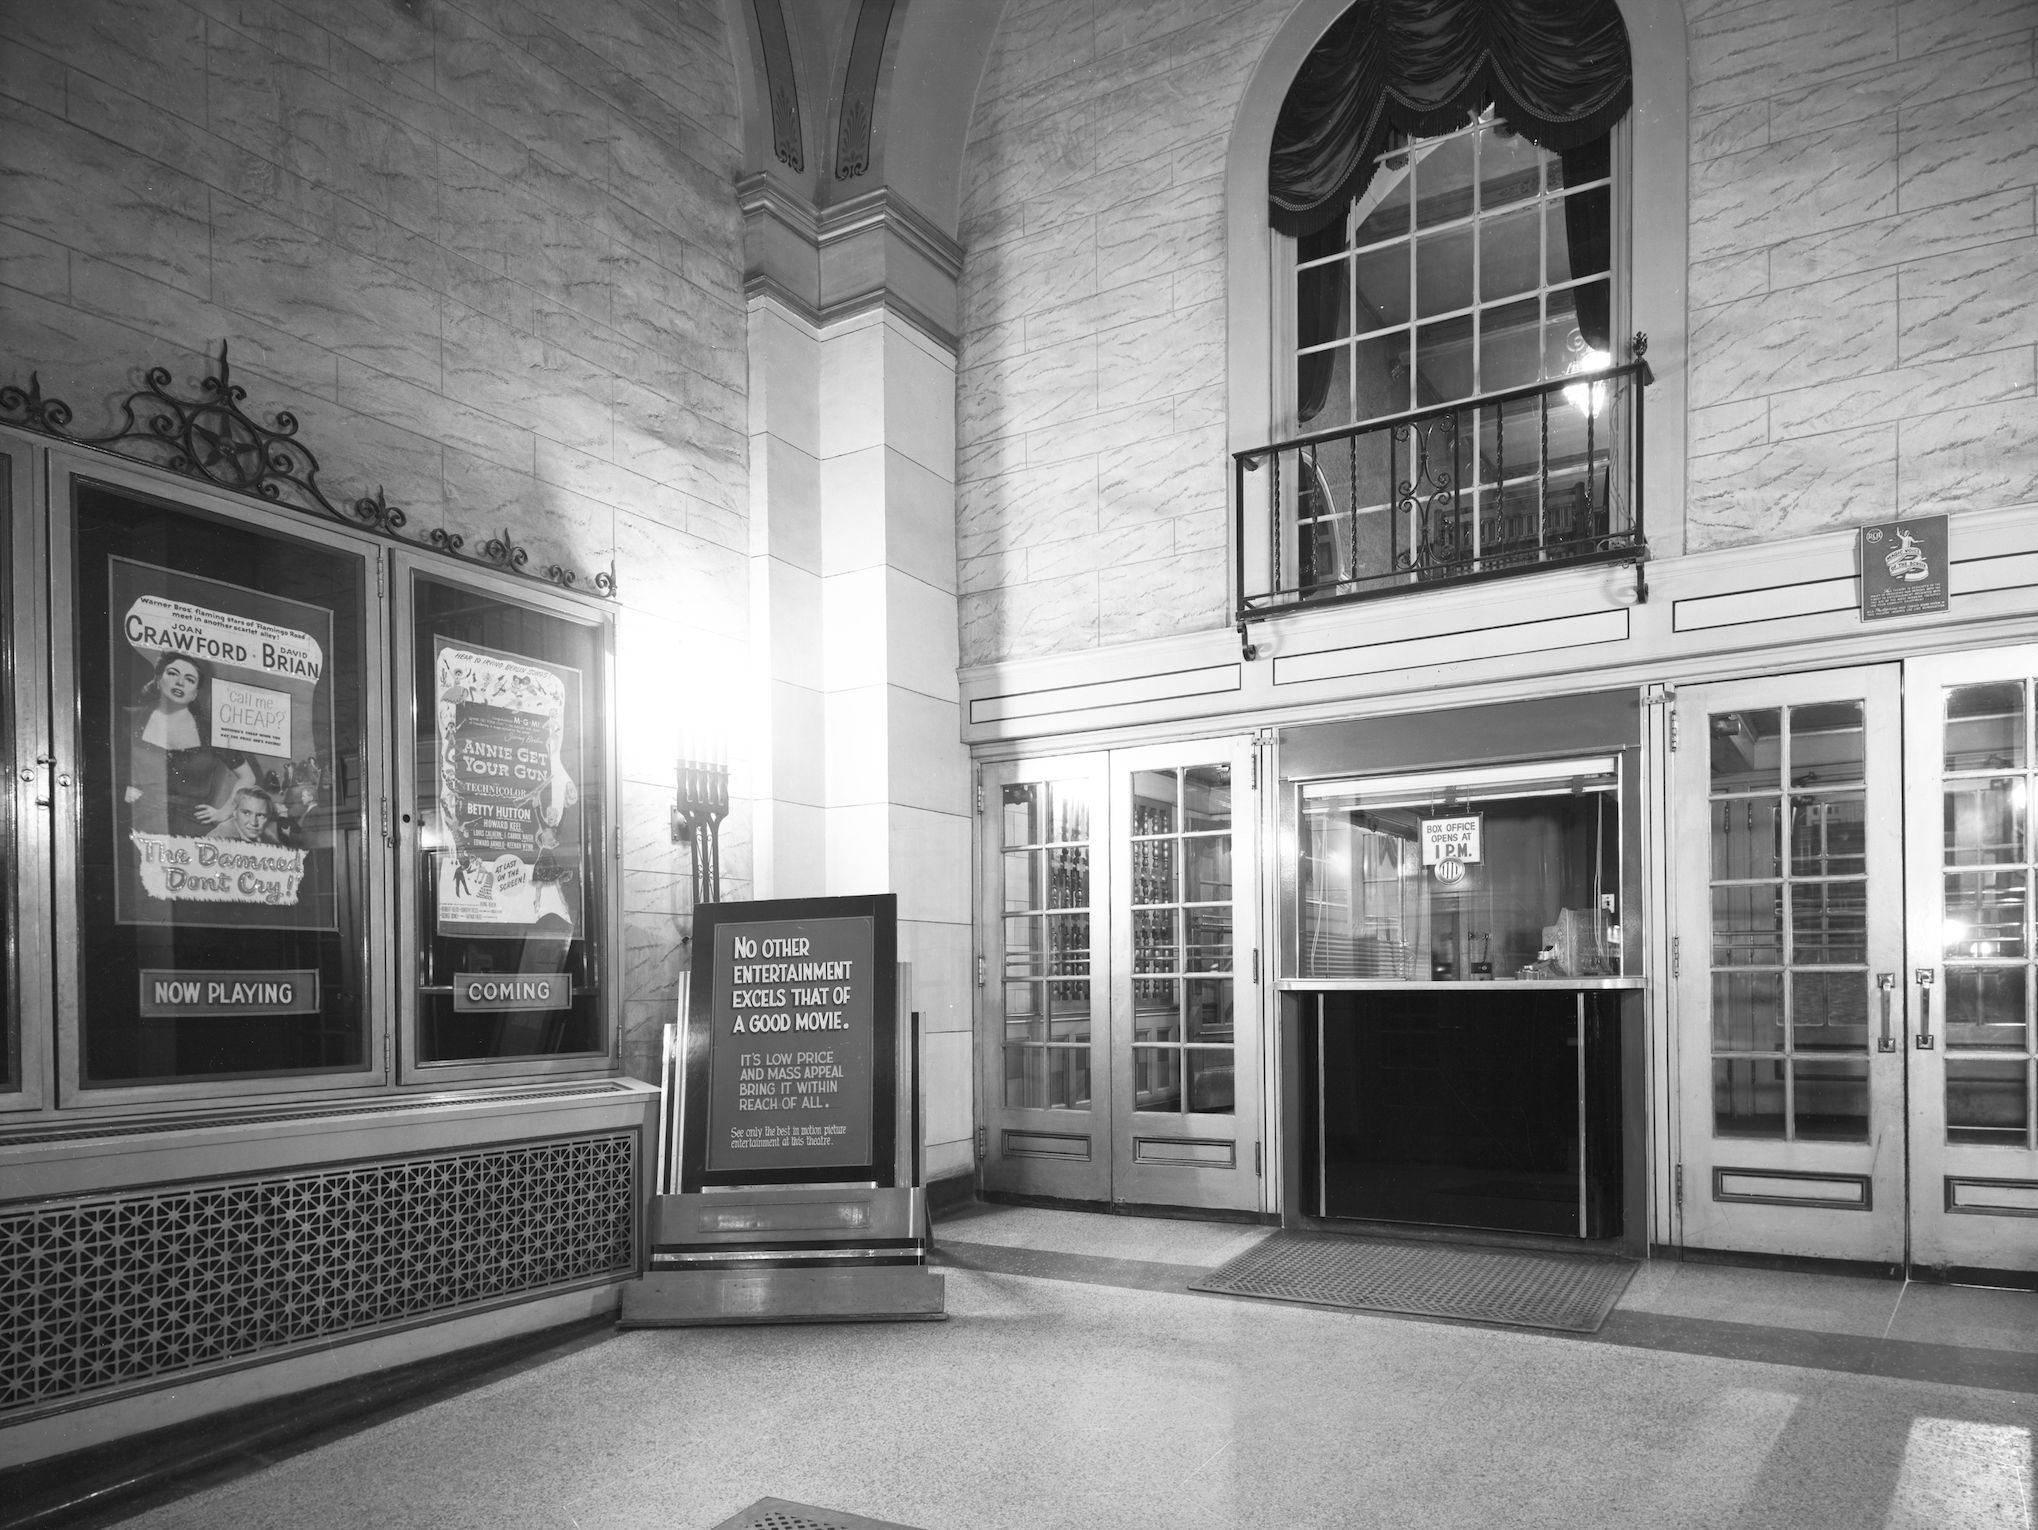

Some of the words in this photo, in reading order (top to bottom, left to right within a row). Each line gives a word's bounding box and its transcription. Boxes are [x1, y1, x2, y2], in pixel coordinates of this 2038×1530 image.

[141, 597, 172, 609] Warner
[195, 609, 225, 622] flaming
[172, 612, 192, 621] meet
[204, 617, 232, 630] another
[234, 624, 258, 635] scarlet
[172, 623, 202, 635] JOAN
[126, 615, 247, 662] CRAWFORD
[263, 643, 319, 678] BRIAN
[280, 647, 308, 659] DAVID
[455, 653, 473, 662] HEAR
[483, 659, 503, 669] IRVING
[505, 664, 527, 673] BERLIN
[256, 698, 273, 709] me
[462, 739, 513, 760] ANNIE
[517, 747, 549, 766] GET
[463, 756, 509, 777] YOUR
[514, 764, 548, 782] GUN
[466, 783, 527, 797] TECHNICOLOR
[467, 803, 493, 816] BETTY
[496, 806, 531, 820] HUTTON
[484, 819, 508, 829] HOWARD
[509, 822, 522, 831] KEEL
[1427, 825, 1442, 833] BOX
[1446, 822, 1475, 832] OFFICE
[1431, 834, 1458, 843] OPENS
[1462, 833, 1472, 841] AT
[138, 837, 193, 865] The
[195, 841, 303, 873] Damned
[1446, 843, 1472, 857] P.M.
[495, 864, 503, 874] AT
[497, 873, 507, 882] ON
[508, 869, 520, 880] THE
[499, 873, 526, 892] SCREEN!
[762, 938, 810, 958] OTHER
[733, 961, 852, 984] ENTERTAINMENT
[155, 981, 201, 1004] NOW
[208, 983, 293, 1004] PLAYING
[468, 981, 550, 1001] COMING
[732, 989, 786, 1008] EXCELS
[791, 987, 829, 1006] THAT
[832, 986, 851, 1005] OF
[732, 1015, 745, 1034] A
[749, 1013, 791, 1033] GOOD
[795, 1011, 849, 1031] MOVIE.
[740, 1053, 761, 1066] IT'S
[766, 1053, 792, 1065] LOW
[797, 1051, 834, 1064] PRICE
[740, 1067, 764, 1081] AND
[767, 1067, 801, 1080] MASS
[804, 1066, 844, 1079] APPEAL
[739, 1083, 776, 1096] BRING
[781, 1082, 792, 1094] IT
[797, 1080, 837, 1094] WITHIN
[739, 1097, 777, 1111] REACH
[781, 1096, 797, 1109] OF
[802, 1096, 830, 1109] ALL.
[730, 1127, 744, 1138] See
[745, 1126, 763, 1139] only
[764, 1125, 775, 1137] the
[776, 1125, 790, 1136] best
[792, 1126, 800, 1135] in
[801, 1125, 822, 1135] motion
[823, 1124, 846, 1136] picture
[730, 1137, 780, 1149] entertainment
[782, 1137, 790, 1146] at
[791, 1136, 804, 1146] this
[806, 1135, 834, 1146] theatre.
